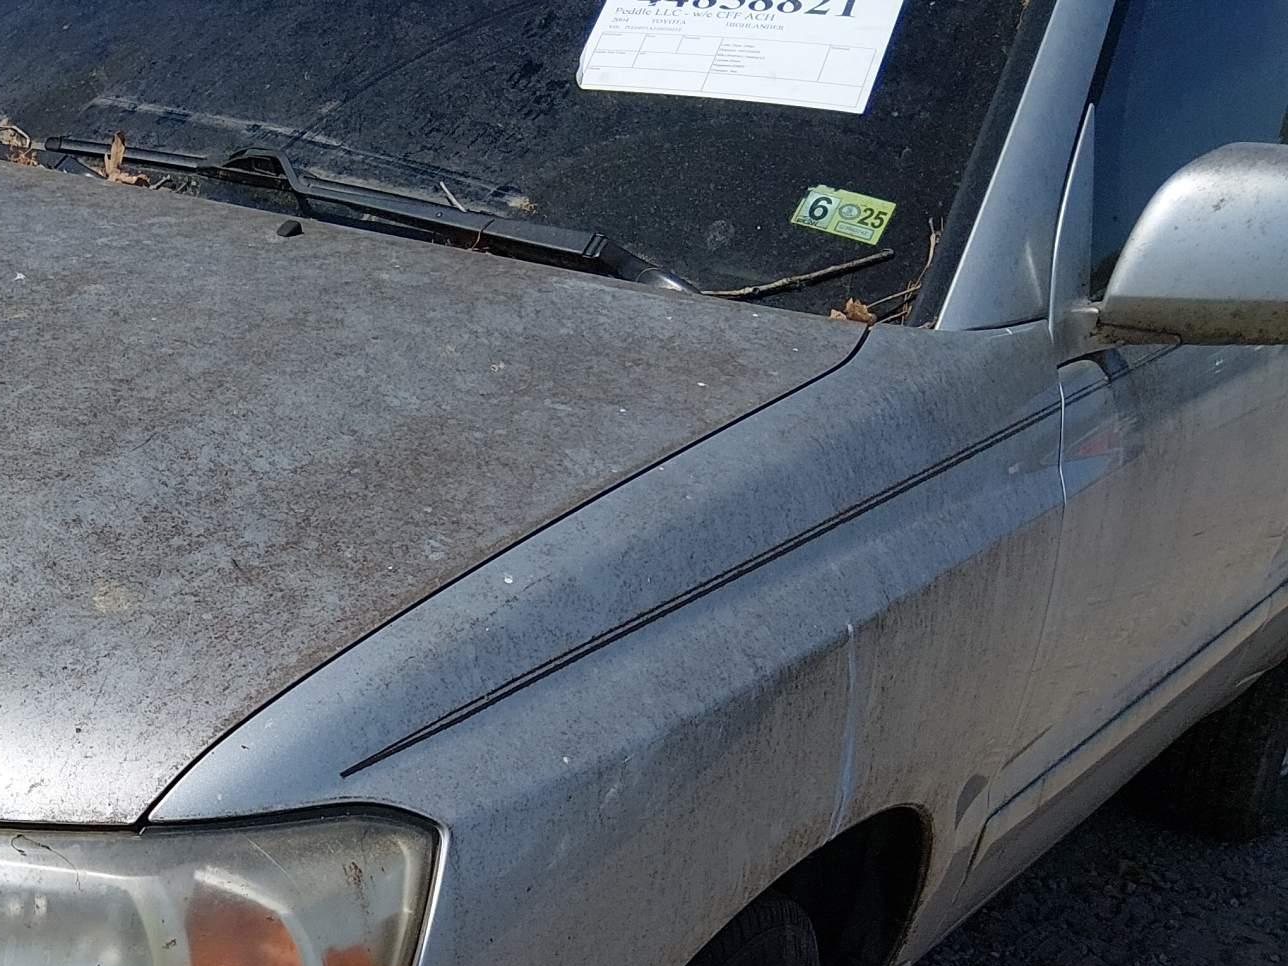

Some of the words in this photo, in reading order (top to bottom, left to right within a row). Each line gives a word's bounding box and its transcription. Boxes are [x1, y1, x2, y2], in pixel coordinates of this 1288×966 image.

[615, 7, 652, 16] Peddle
[655, 8, 682, 17] LLC
[745, 13, 775, 21] ACH
[726, 22, 785, 31] HIGHLANDER
[808, 196, 833, 221] 6
[857, 207, 888, 229] 25
